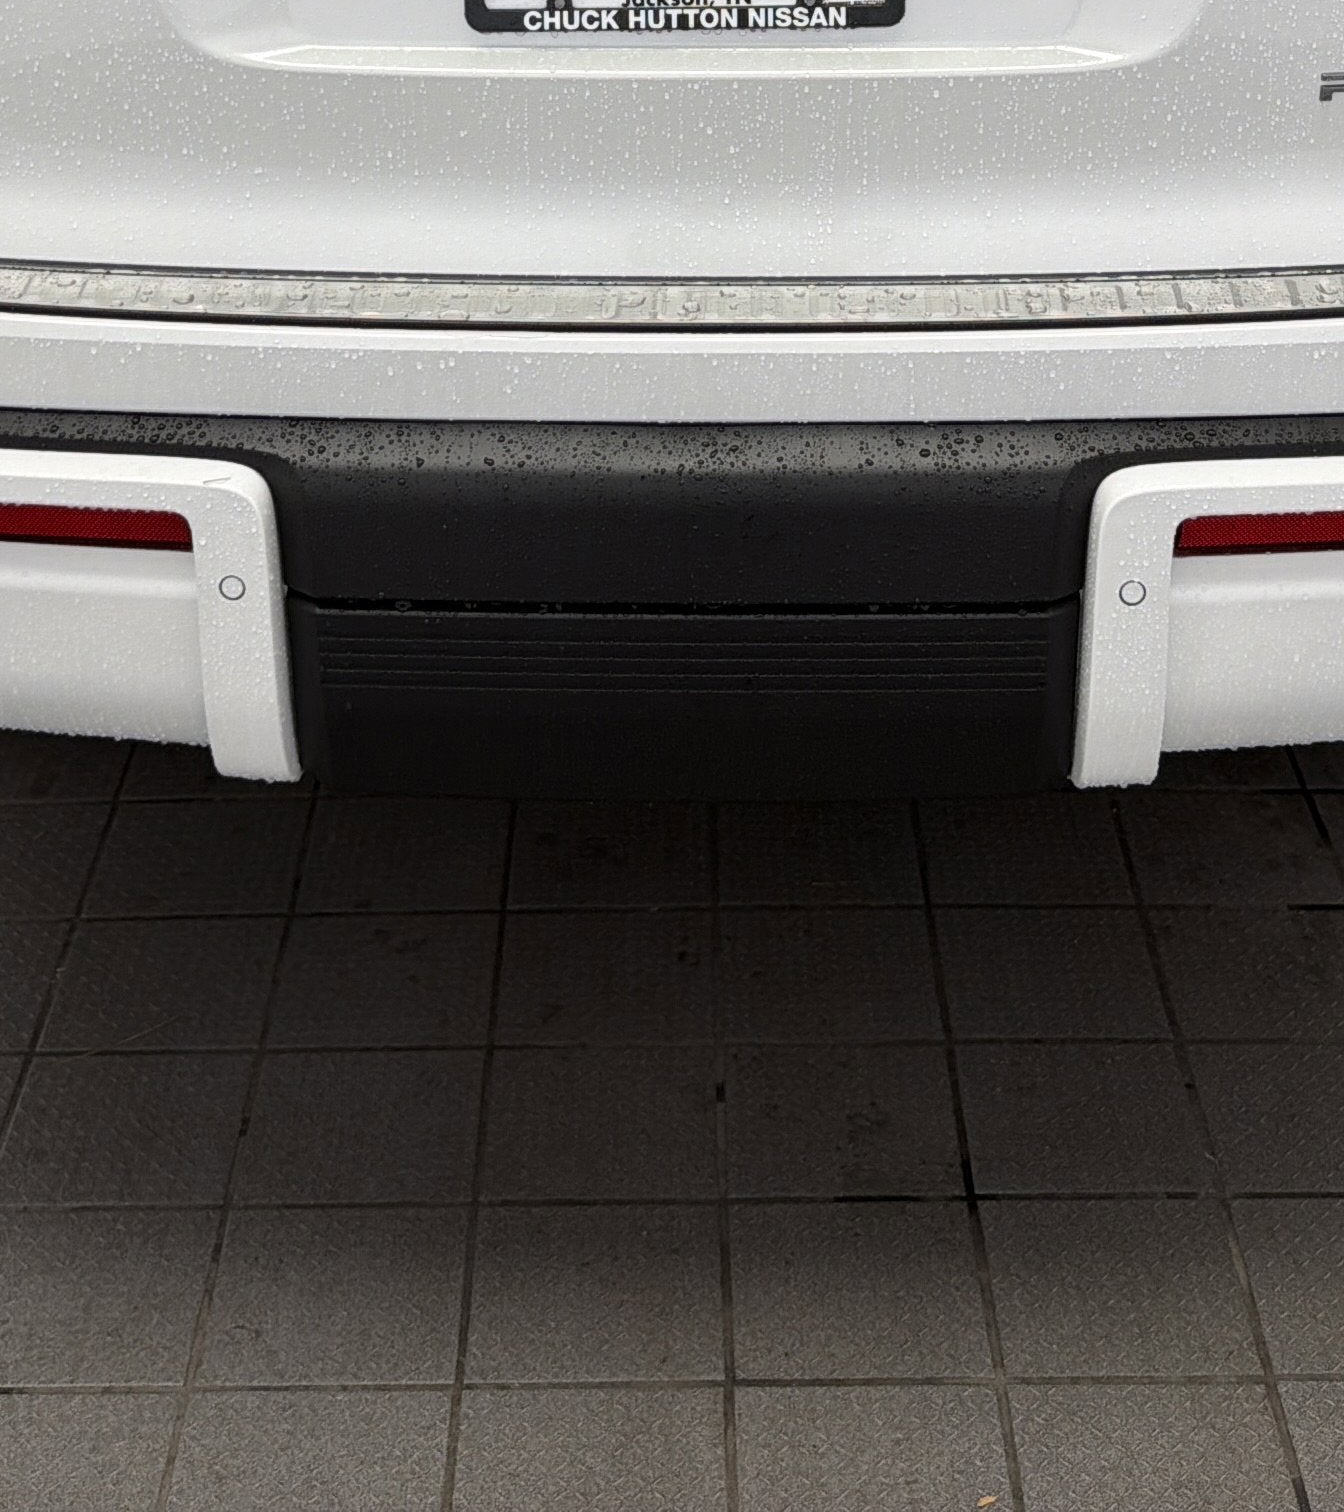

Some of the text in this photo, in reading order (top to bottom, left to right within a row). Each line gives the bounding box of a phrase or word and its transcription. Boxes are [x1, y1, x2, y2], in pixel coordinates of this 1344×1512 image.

[523, 6, 847, 31] CHUCK HUTTON NISSAN
